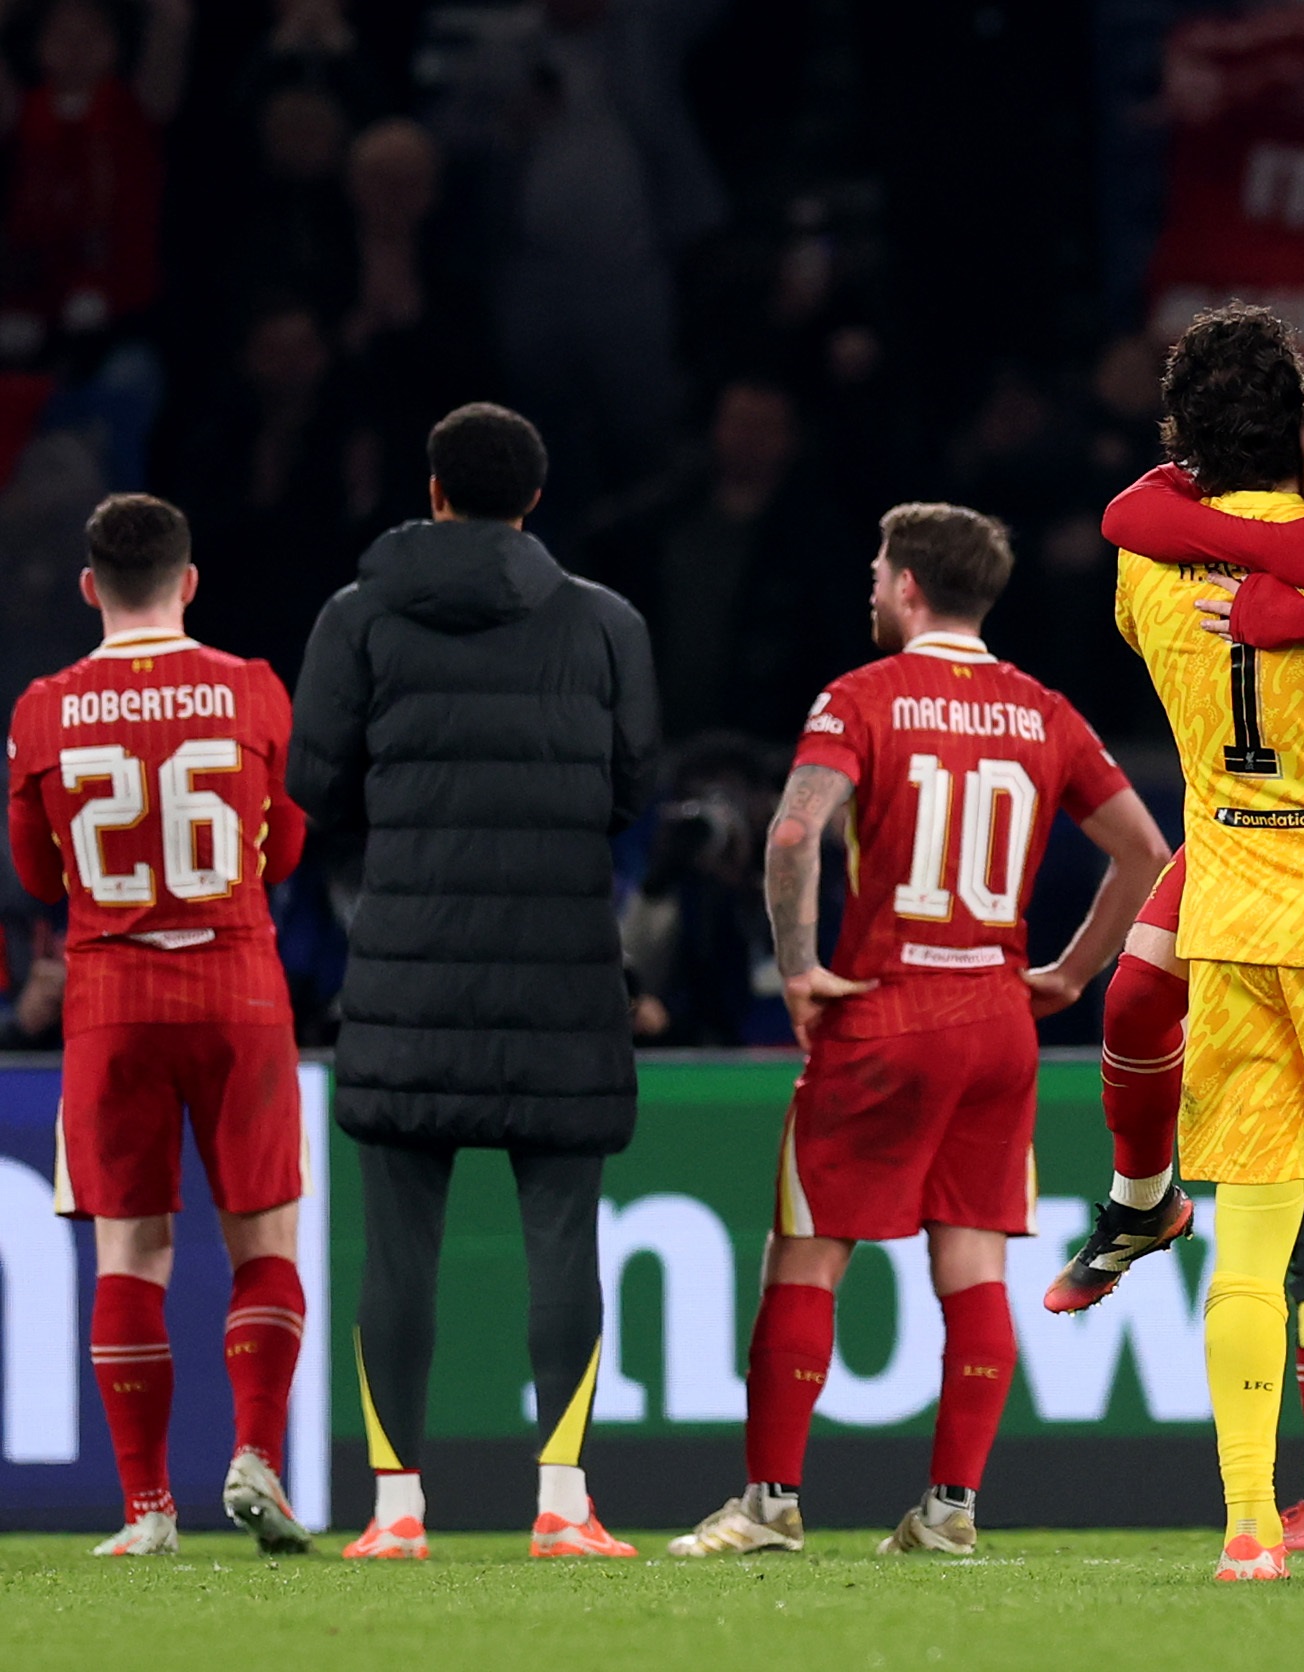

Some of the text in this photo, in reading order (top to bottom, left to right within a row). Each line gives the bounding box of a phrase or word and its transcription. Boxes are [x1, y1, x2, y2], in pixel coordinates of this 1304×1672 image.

[61, 684, 236, 728] ROBERTSON
[893, 697, 1046, 742] MAC ALLISTER
[1221, 613, 1283, 778] 1
[60, 739, 242, 907] 26
[894, 753, 1040, 927] 10
[522, 1191, 1218, 1426] now
[963, 1365, 999, 1379] LFC
[1243, 1380, 1274, 1391] LFC
